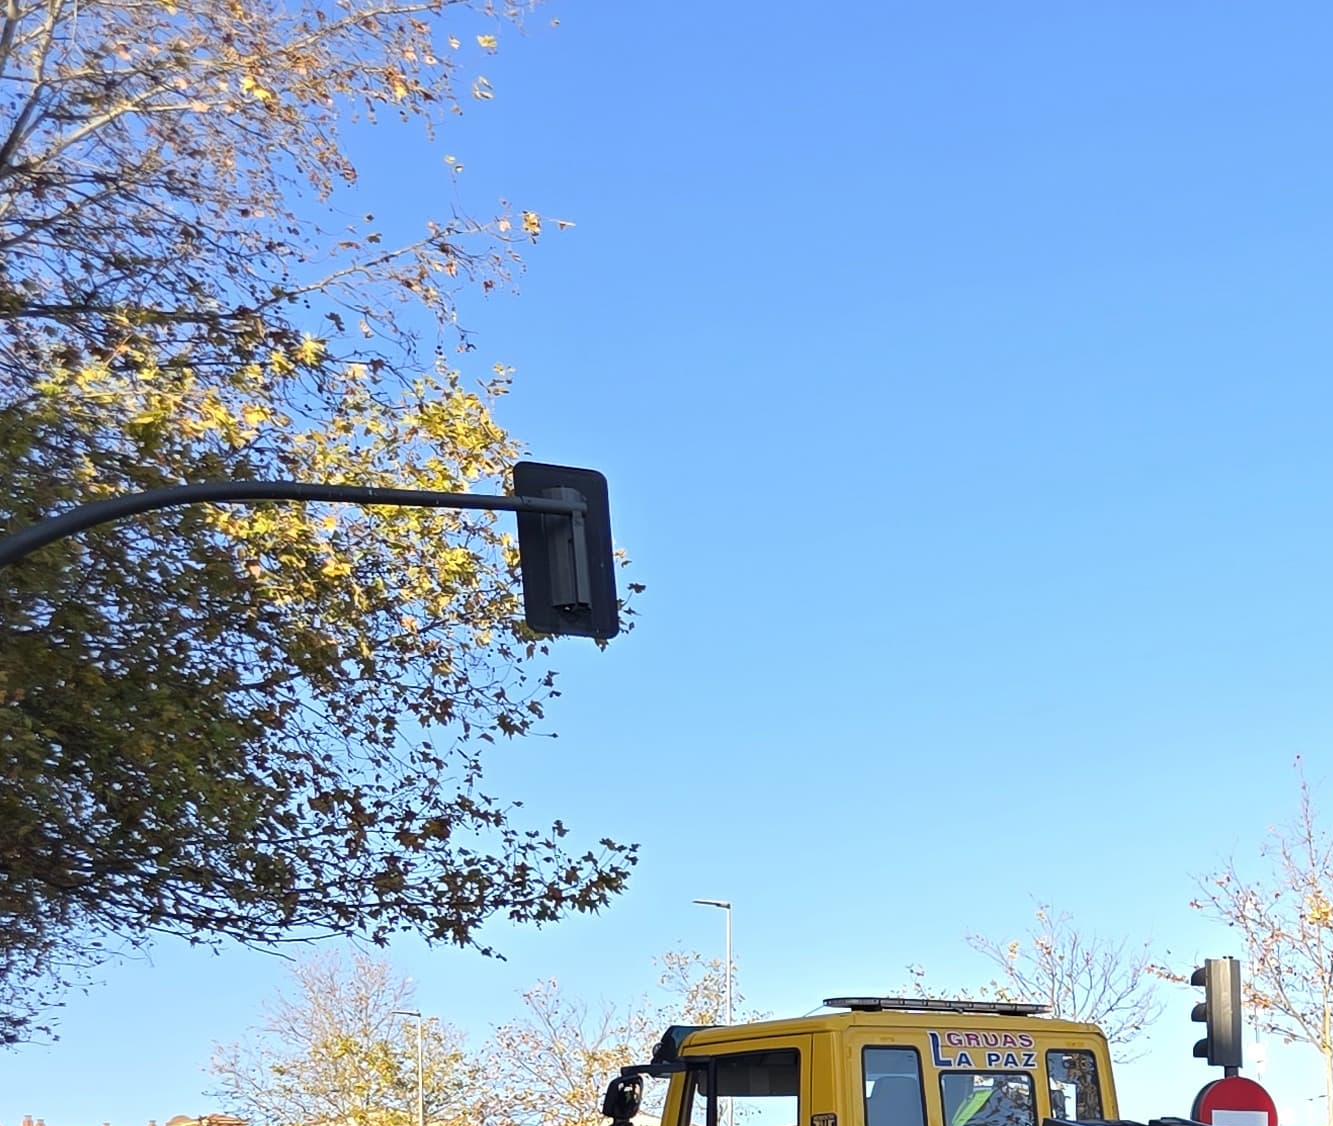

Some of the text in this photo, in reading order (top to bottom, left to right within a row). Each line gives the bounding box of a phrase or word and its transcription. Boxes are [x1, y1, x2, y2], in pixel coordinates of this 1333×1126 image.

[928, 1032, 1037, 1067] LA PAZ
[946, 1032, 1034, 1048] GRUAS
